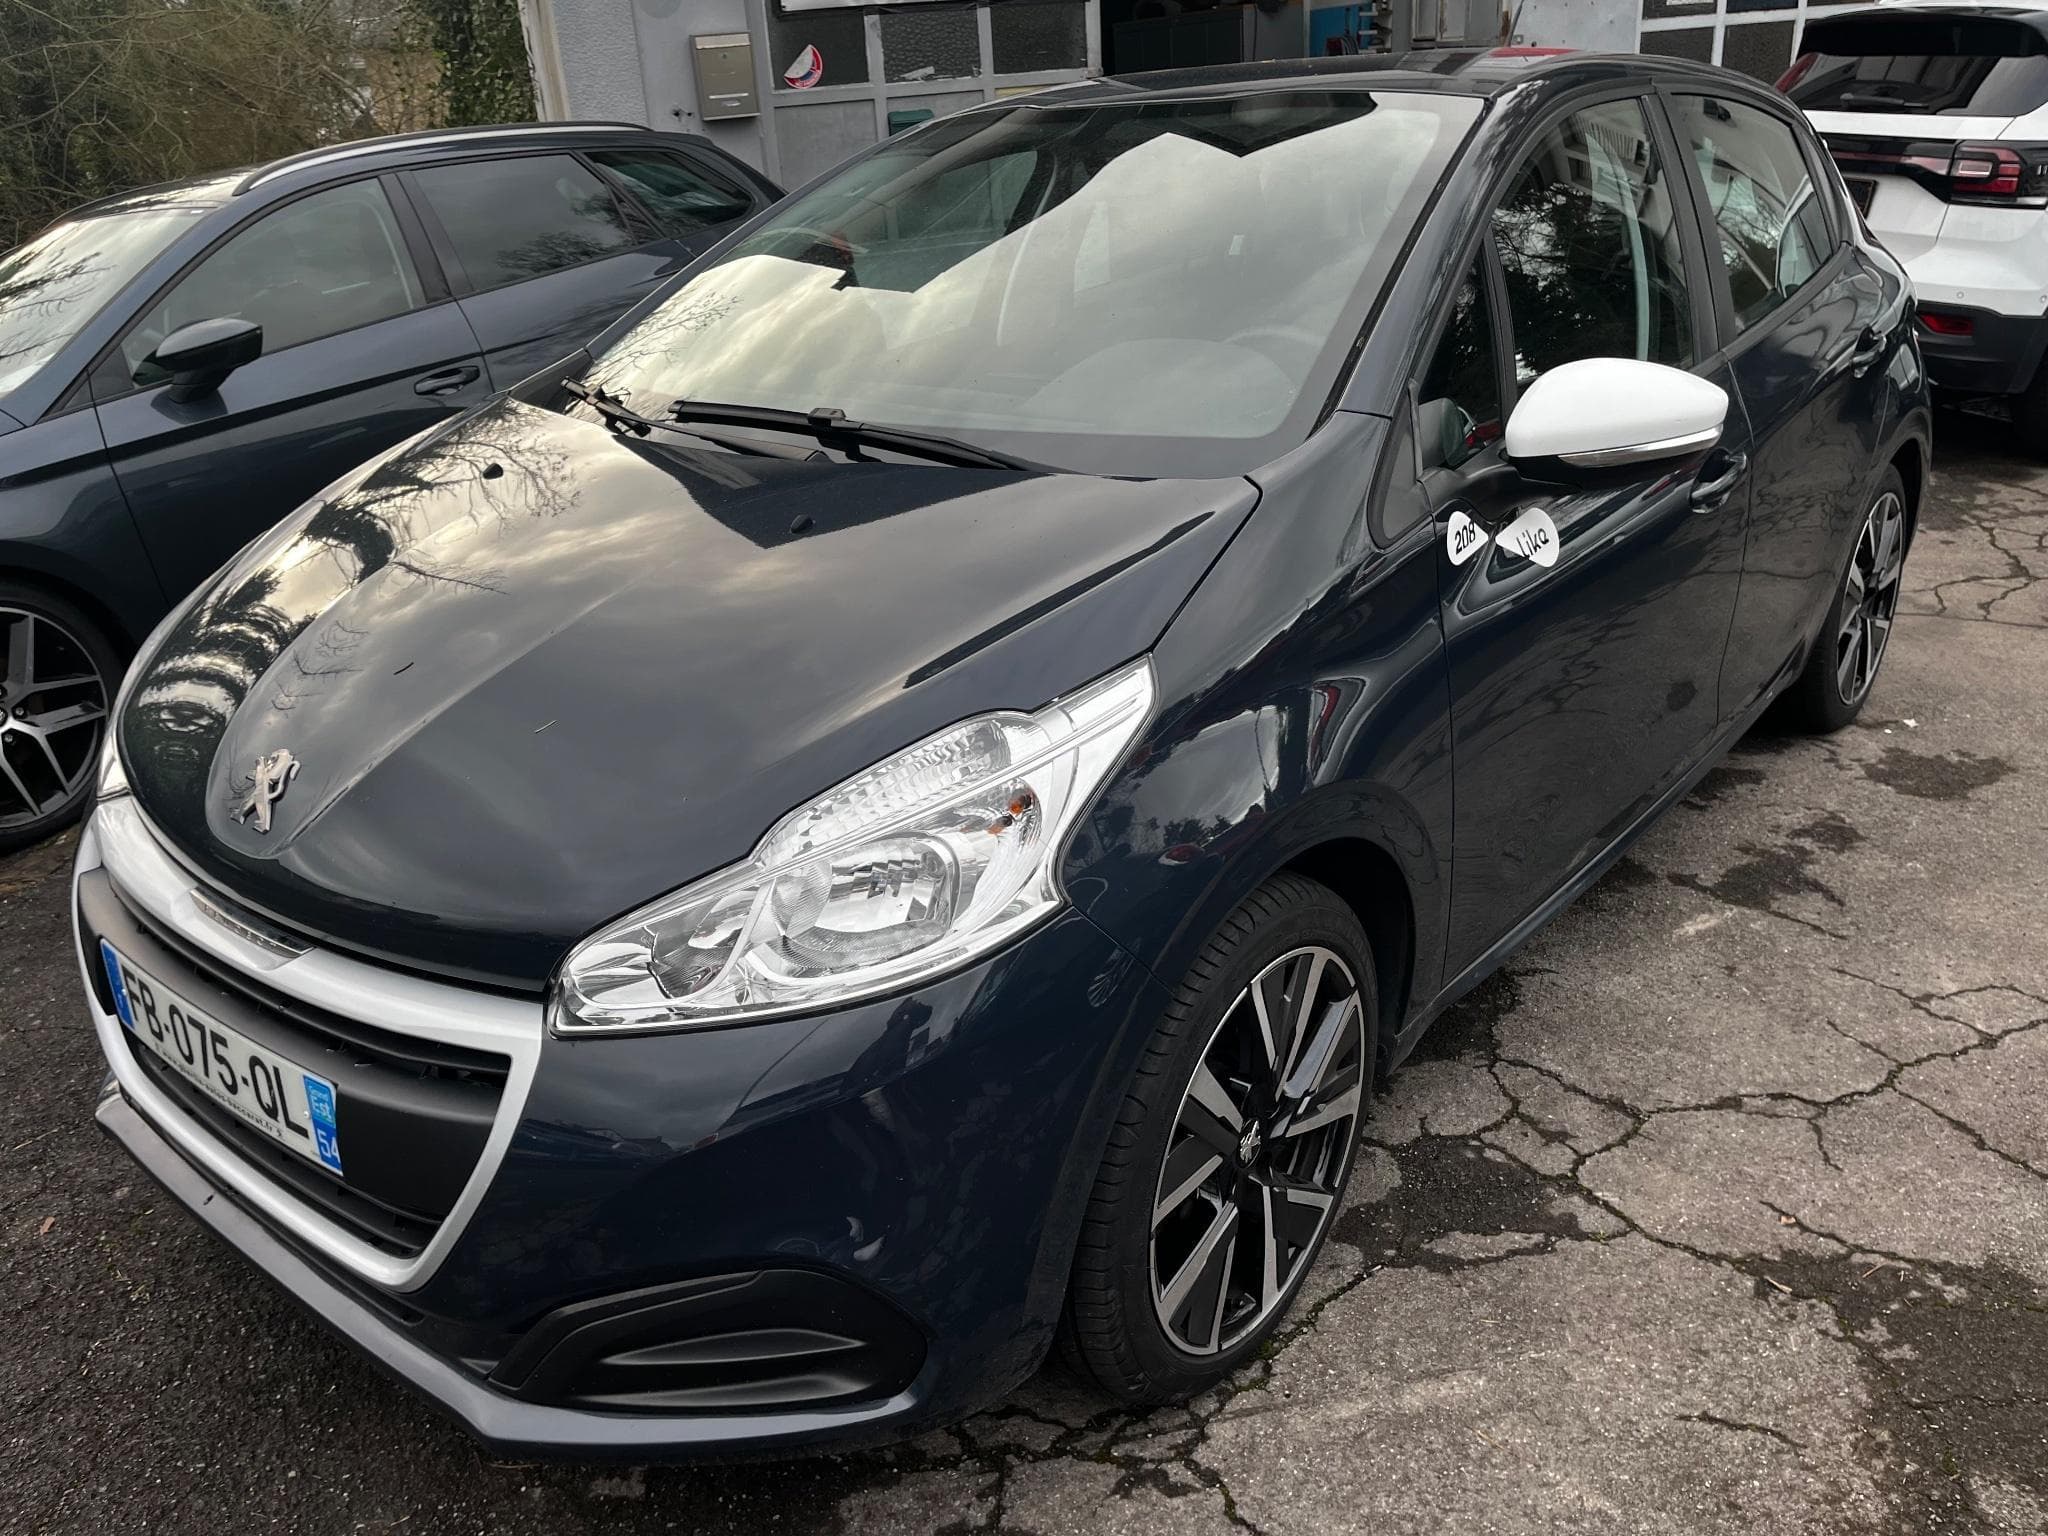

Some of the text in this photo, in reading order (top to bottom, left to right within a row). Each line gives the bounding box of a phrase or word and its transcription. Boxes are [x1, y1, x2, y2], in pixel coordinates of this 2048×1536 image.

[1455, 521, 1476, 555] 208
[121, 964, 309, 1139] FB-075-QL
[317, 1128, 341, 1164] 54
